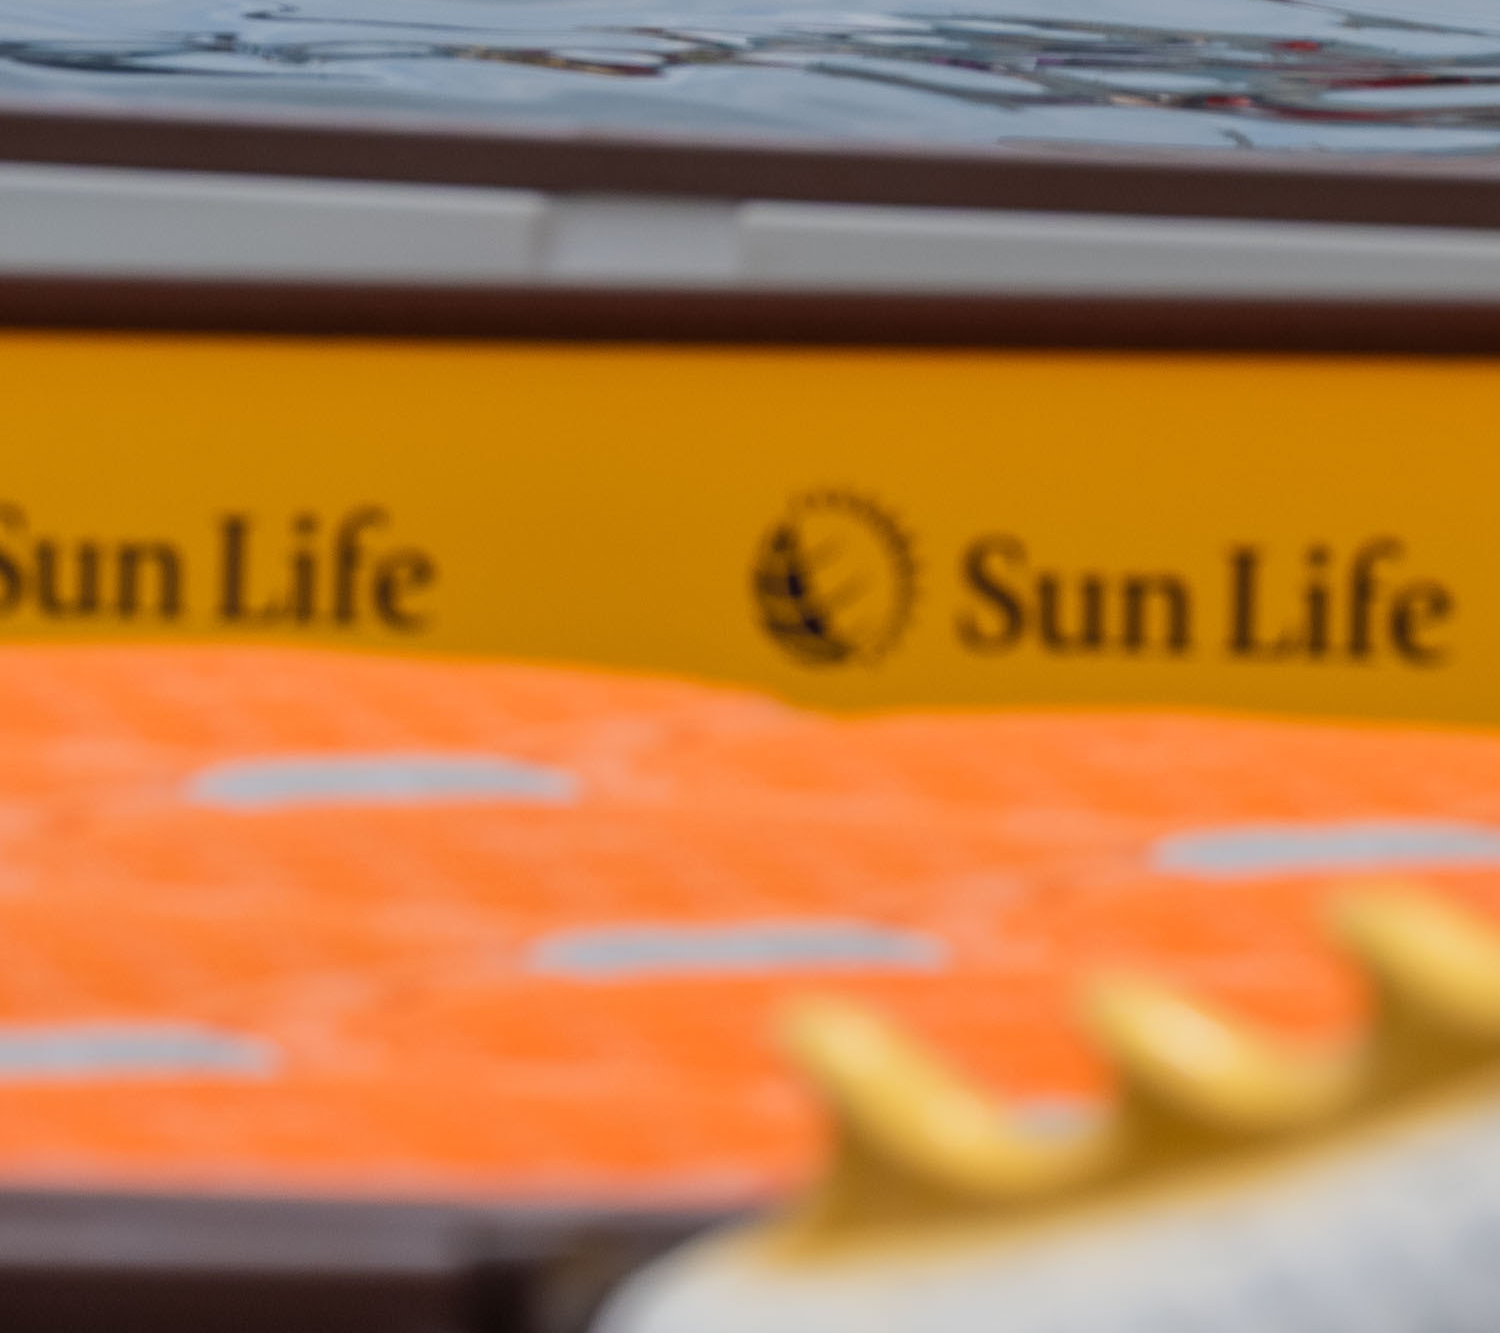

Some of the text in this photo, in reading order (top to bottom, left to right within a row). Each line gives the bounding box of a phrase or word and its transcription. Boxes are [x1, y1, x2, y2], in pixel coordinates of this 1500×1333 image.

[216, 508, 440, 635] Life
[955, 533, 1458, 668] Sun Life
